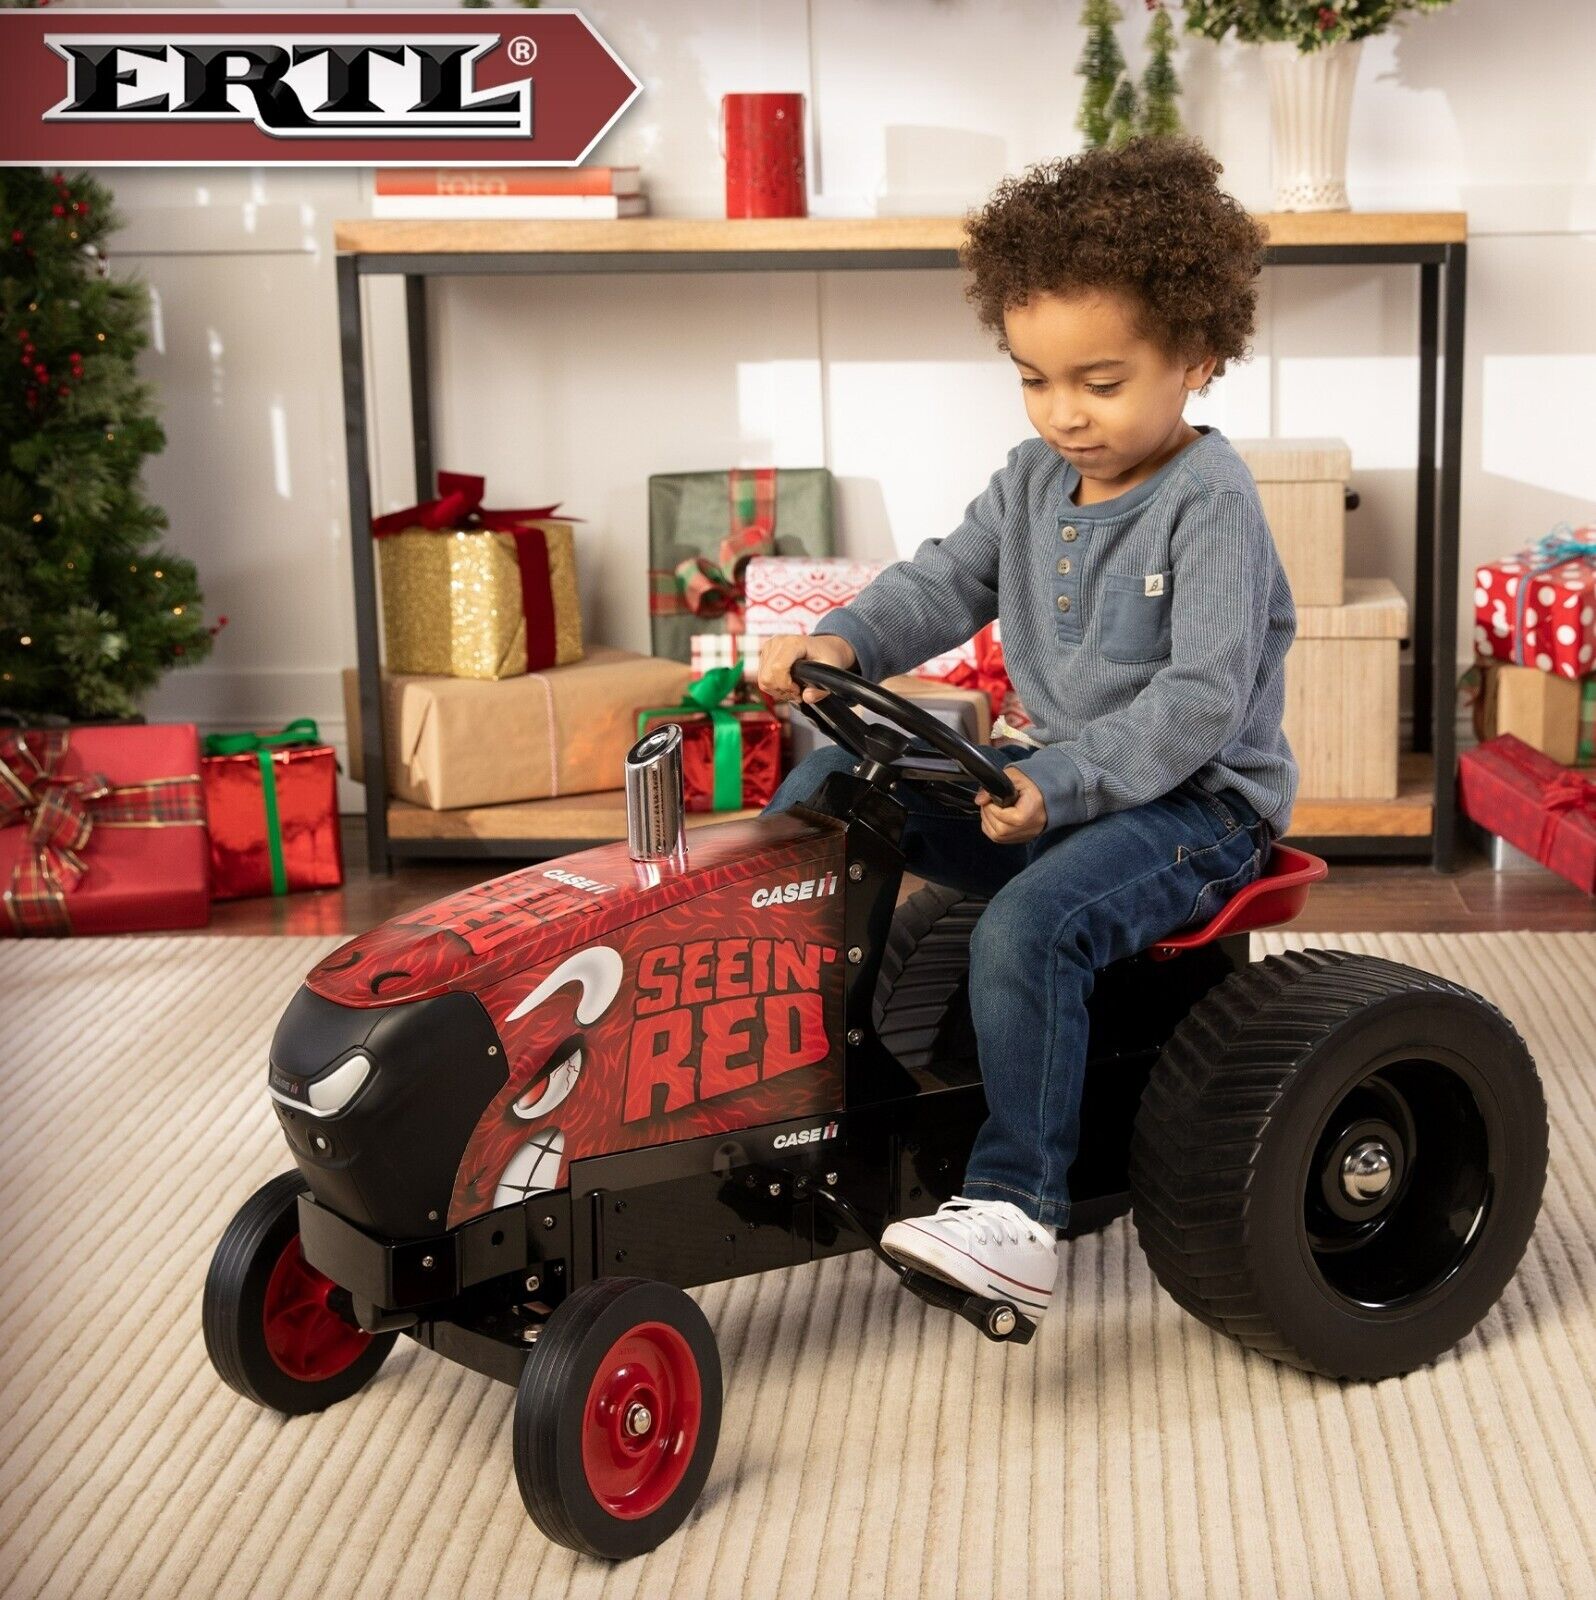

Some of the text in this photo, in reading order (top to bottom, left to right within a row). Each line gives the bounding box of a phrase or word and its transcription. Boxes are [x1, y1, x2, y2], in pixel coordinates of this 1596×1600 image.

[542, 869, 600, 889] CASE
[751, 879, 816, 908] CASE
[635, 937, 837, 1016] SEEIN'
[622, 992, 831, 1124] RED
[773, 1127, 823, 1149] CASE
